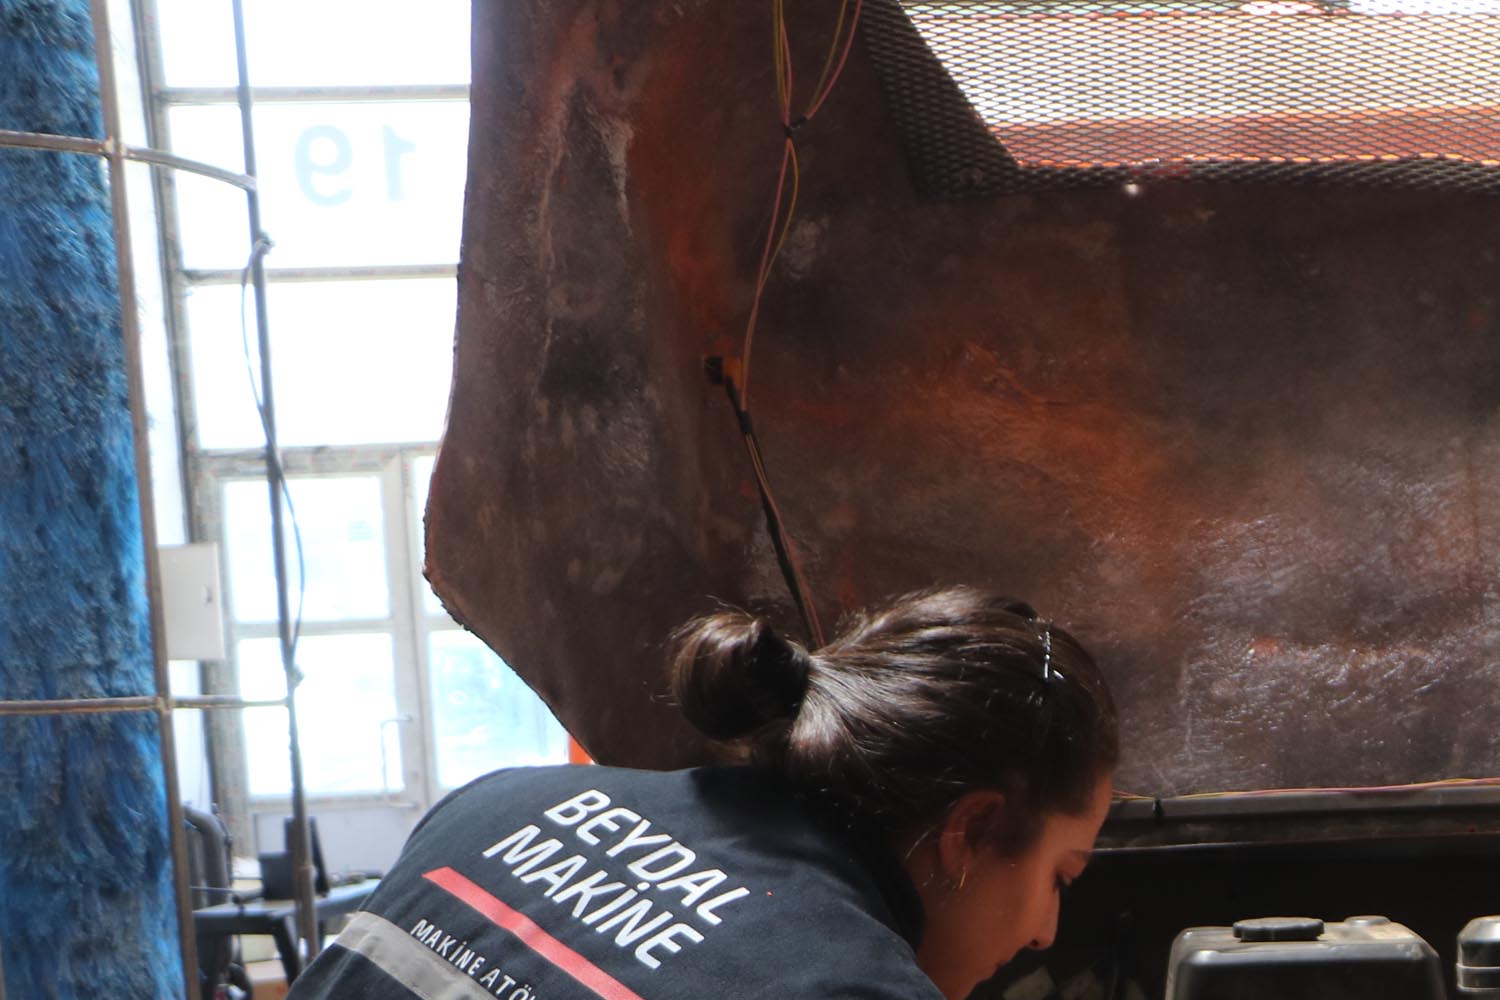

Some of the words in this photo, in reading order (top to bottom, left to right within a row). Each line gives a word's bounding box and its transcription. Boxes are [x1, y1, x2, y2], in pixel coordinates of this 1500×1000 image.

[482, 824, 705, 970] MAKİNE
[543, 788, 751, 926] BEYDAL
[410, 919, 486, 976] MAKİNE
